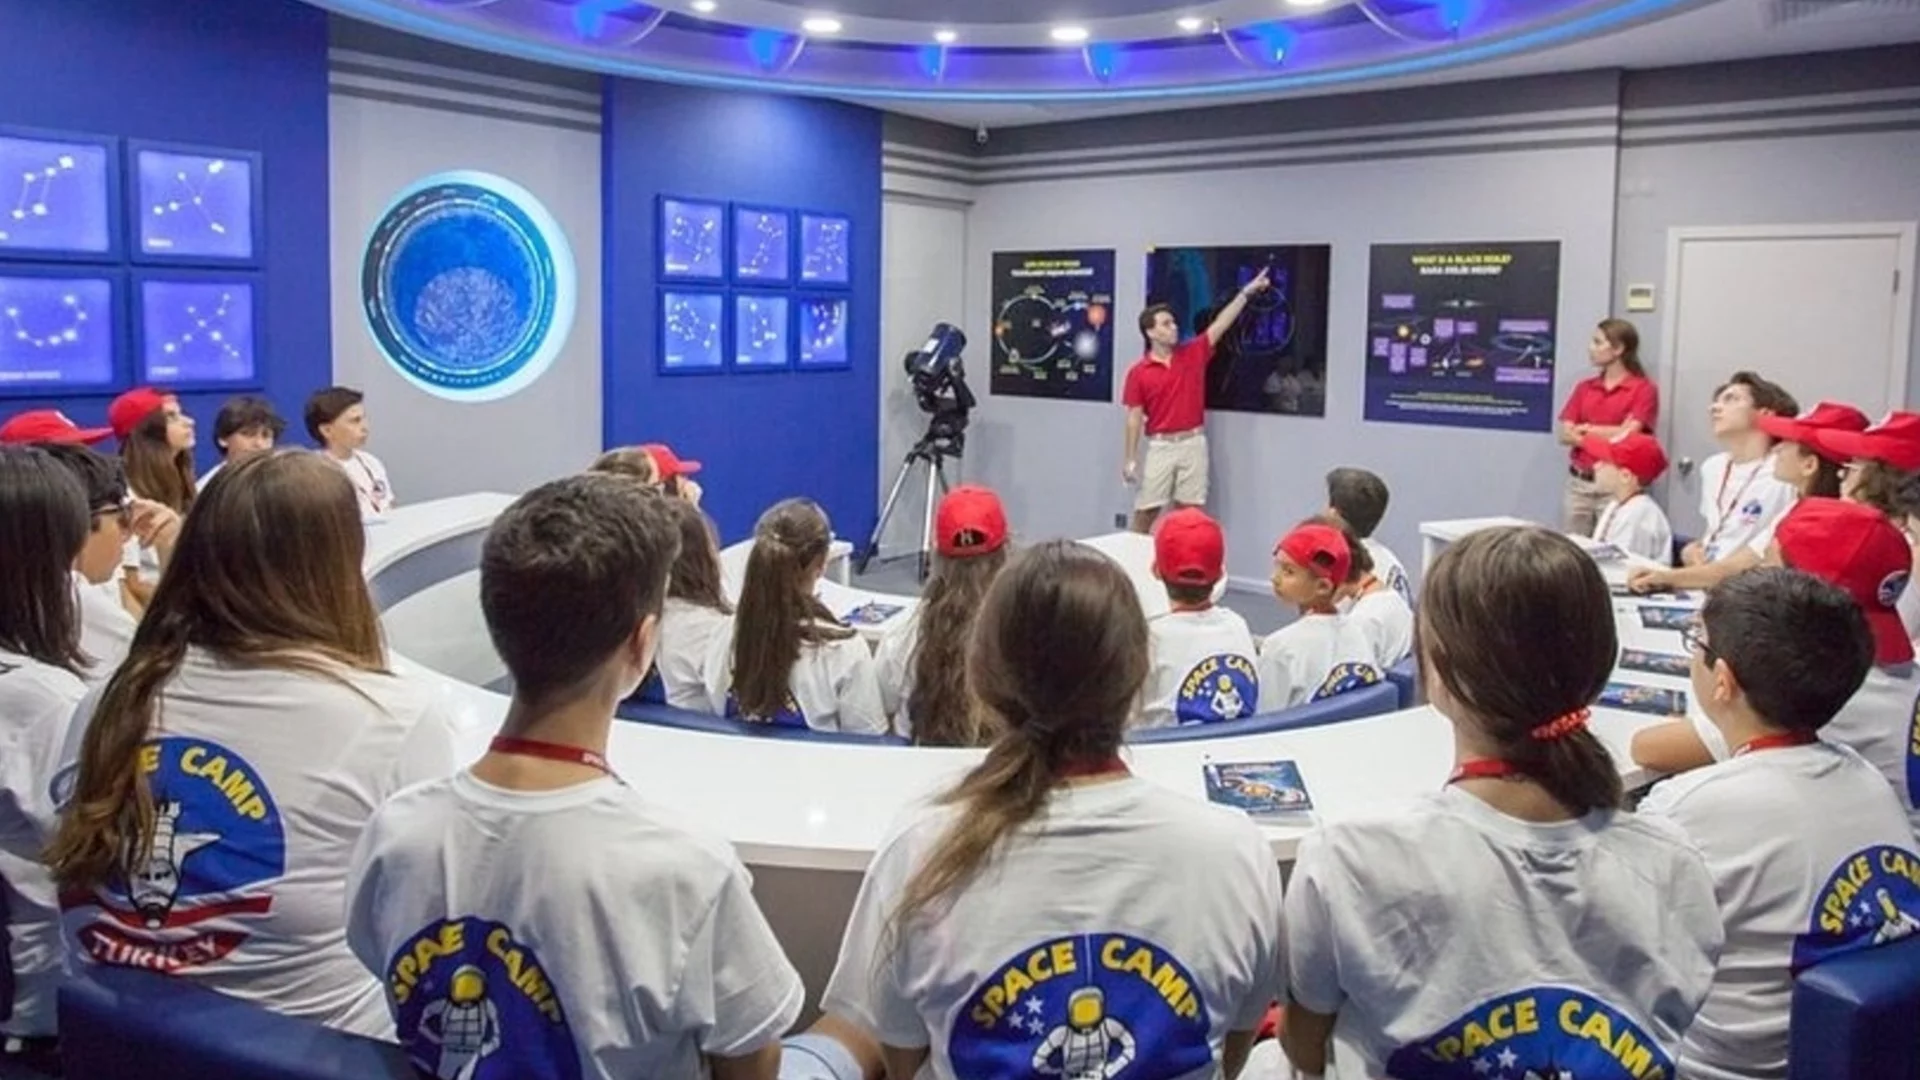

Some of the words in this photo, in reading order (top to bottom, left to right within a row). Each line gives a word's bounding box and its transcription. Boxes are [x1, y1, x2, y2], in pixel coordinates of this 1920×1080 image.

[180, 747, 267, 821] CAMP
[1820, 855, 1872, 934] SPACE
[972, 940, 1076, 1029] SPACE
[1101, 938, 1198, 1018] CAMP
[1422, 997, 1539, 1063] PACE
